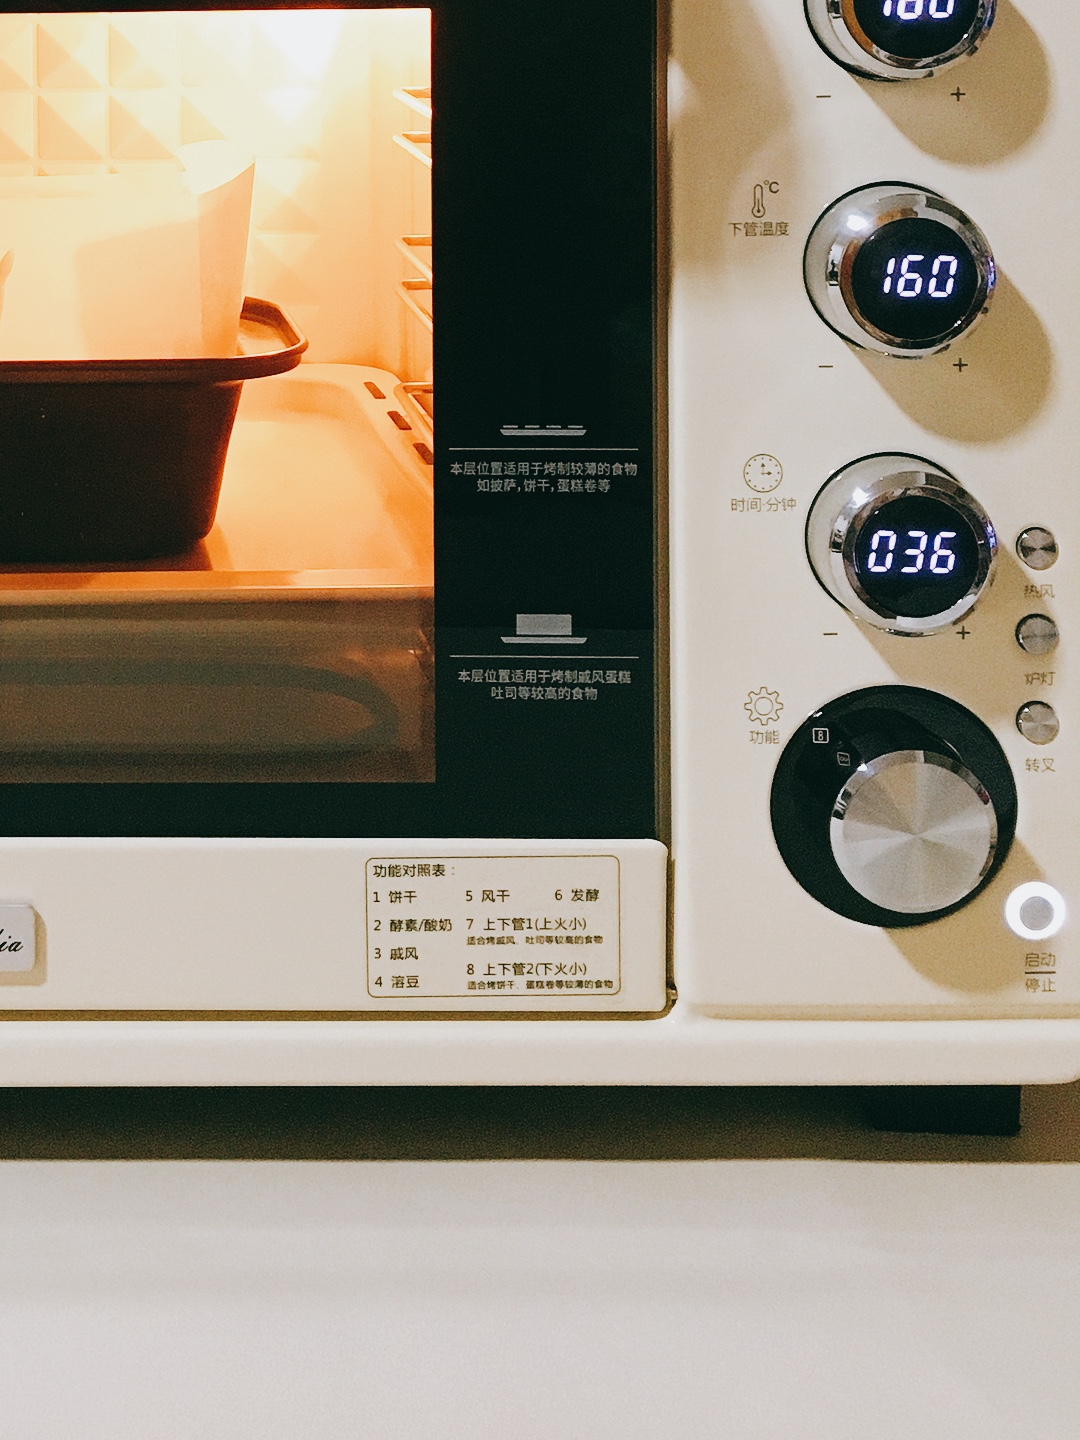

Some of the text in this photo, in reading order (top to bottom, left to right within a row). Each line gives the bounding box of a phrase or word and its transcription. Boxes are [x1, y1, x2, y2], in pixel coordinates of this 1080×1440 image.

[728, 221, 790, 237] 下管温度
[882, 254, 958, 298] 160
[450, 462, 638, 476] 本层位置适用于烤制较薄的食物
[867, 530, 957, 574] 036
[1024, 584, 1055, 599] 热风
[457, 670, 632, 684] 本层位置适用于烤制戚风蛋糕
[1024, 671, 1056, 686] 炉灯
[490, 687, 598, 701] 吐司等较高的食物
[749, 729, 780, 745] 功能
[373, 890, 418, 903] 1 饼干
[465, 889, 511, 903] 5 风干
[554, 888, 600, 902] 6 发酵
[373, 918, 453, 932] 2 酵素/酸奶
[466, 918, 474, 930] 7
[374, 946, 419, 960] 3 戚风
[1024, 952, 1057, 967] 启动
[466, 963, 475, 976] 8
[374, 975, 420, 989] 4 溶豆
[1024, 978, 1057, 993] 停止
